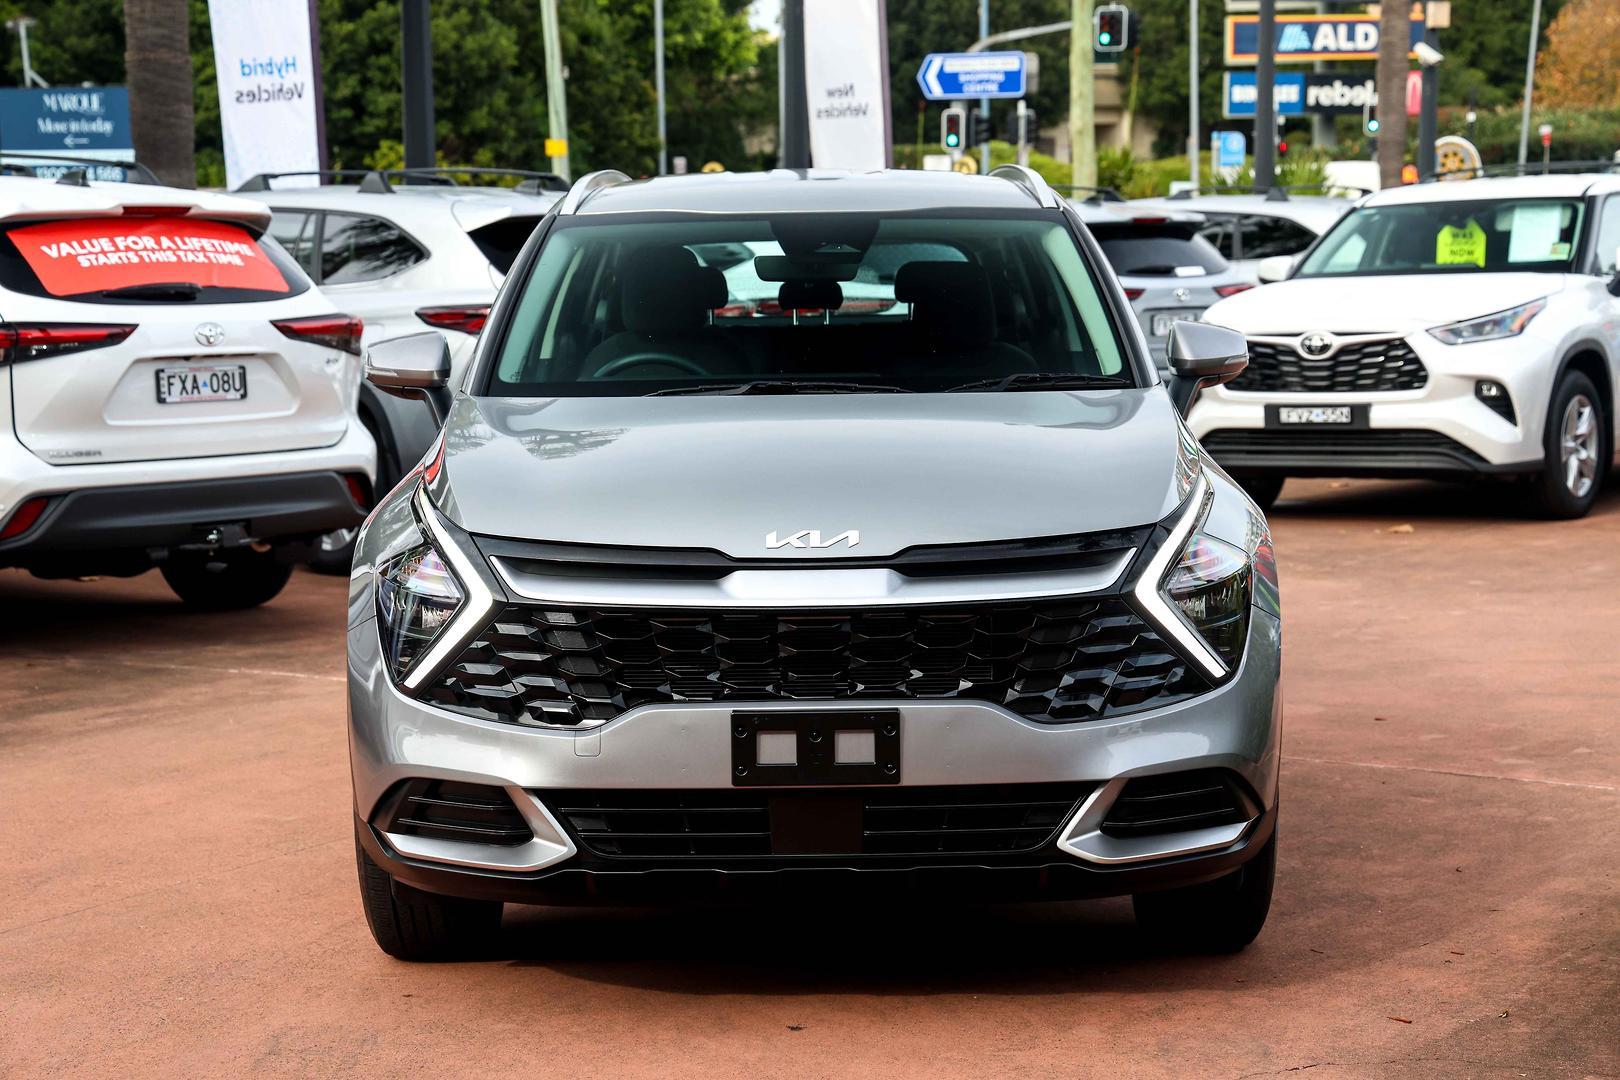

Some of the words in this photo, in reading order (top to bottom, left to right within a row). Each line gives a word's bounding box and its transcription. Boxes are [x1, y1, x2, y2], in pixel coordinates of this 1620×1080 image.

[1312, 23, 1379, 51] ALD
[40, 238, 114, 258] VALUE
[114, 236, 161, 251] FOR
[160, 235, 176, 250] A
[174, 236, 256, 257] LIFETIME
[77, 251, 139, 268] STARTS
[138, 250, 177, 263] THIS
[175, 250, 208, 263] TAX
[206, 252, 245, 267] TIME
[166, 374, 201, 397] FXA
[209, 372, 243, 394] 08U
[765, 529, 860, 549] KIA
